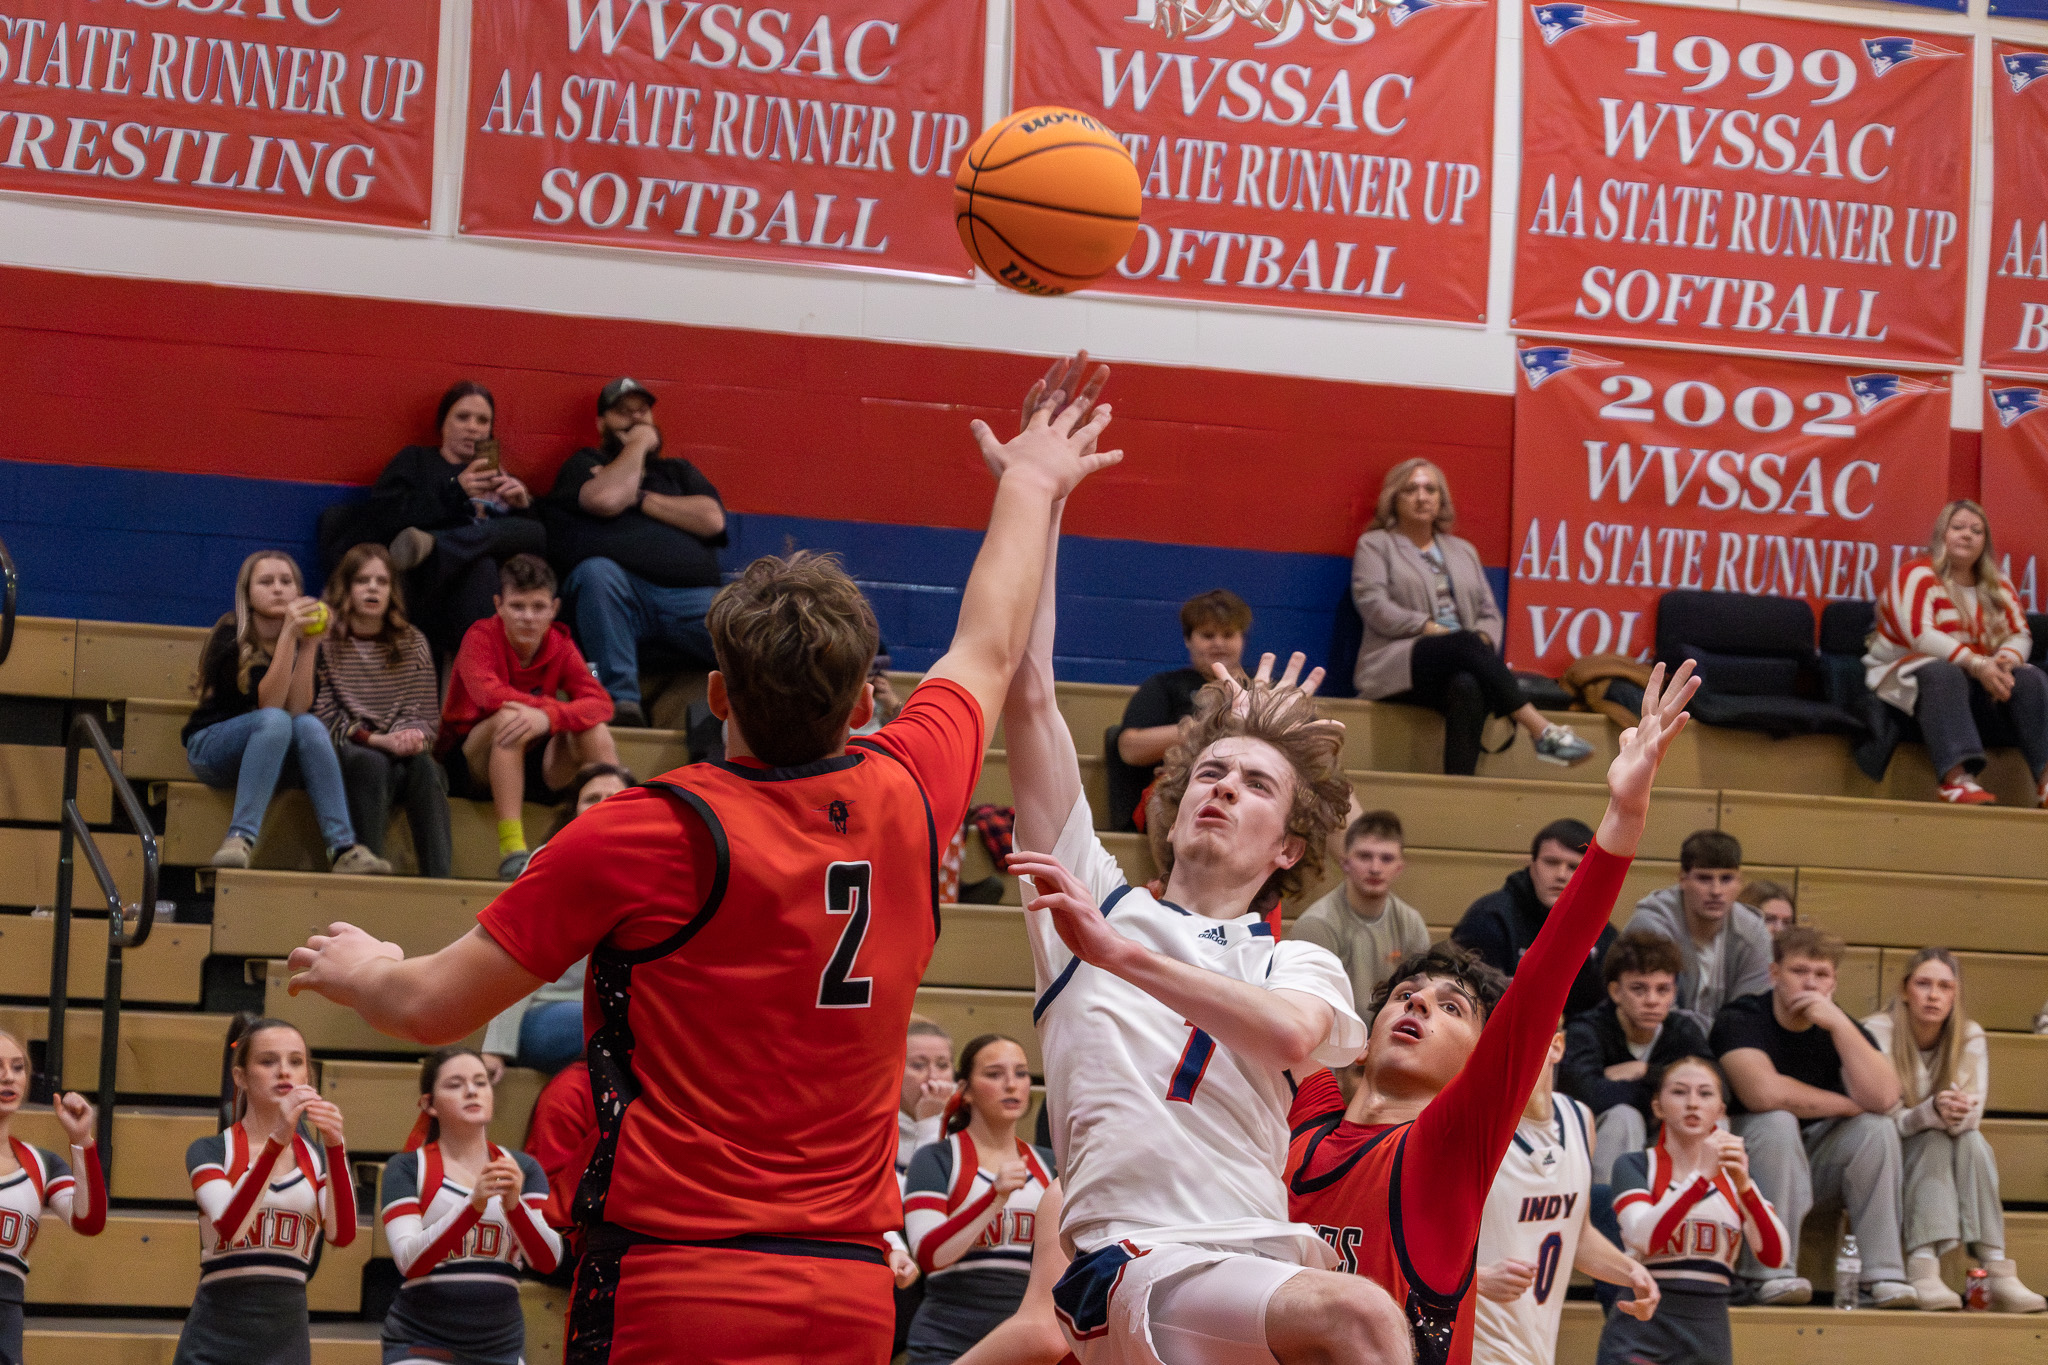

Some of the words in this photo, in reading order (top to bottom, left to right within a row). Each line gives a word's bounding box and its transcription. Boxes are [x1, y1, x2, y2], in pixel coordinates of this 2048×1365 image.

[141, 32, 348, 118] RUNNER
[360, 54, 425, 123] UP
[566, 0, 900, 85] WVSSAC
[1624, 30, 1859, 107] 1999
[480, 68, 545, 138] AA
[554, 74, 701, 153] STATE
[705, 90, 897, 172] RUNNER
[908, 110, 970, 178] UP
[1095, 46, 1415, 137] WVSSAC
[0, 110, 377, 201] RESTLING
[1117, 132, 1229, 206] TATE
[1232, 143, 1413, 222] RUNNER
[1423, 160, 1482, 226] UP
[1598, 97, 1897, 184] WVSSAC
[532, 167, 889, 253] SOFTBALL
[1527, 173, 1587, 239] AA
[1593, 178, 1723, 251] STATE
[1727, 191, 1895, 267] RUNNER
[1903, 207, 1959, 271] UP
[1115, 223, 1407, 300] OFTBALL
[1574, 265, 1890, 342] SOFTBALL
[1598, 374, 1858, 438] 2002
[1582, 440, 1882, 521] WVSSAC
[1514, 517, 1571, 582] AA
[1578, 521, 1708, 590] STATE
[1712, 531, 1881, 602] RUNNER
[1526, 604, 1653, 664] VOL
[815, 859, 873, 1009] 2
[1198, 932, 1228, 946] adidas
[213, 1207, 317, 1260] NDY
[1518, 1192, 1579, 1223] INDY
[1659, 1218, 1741, 1264] NDY
[1533, 1231, 1563, 1306] 0
